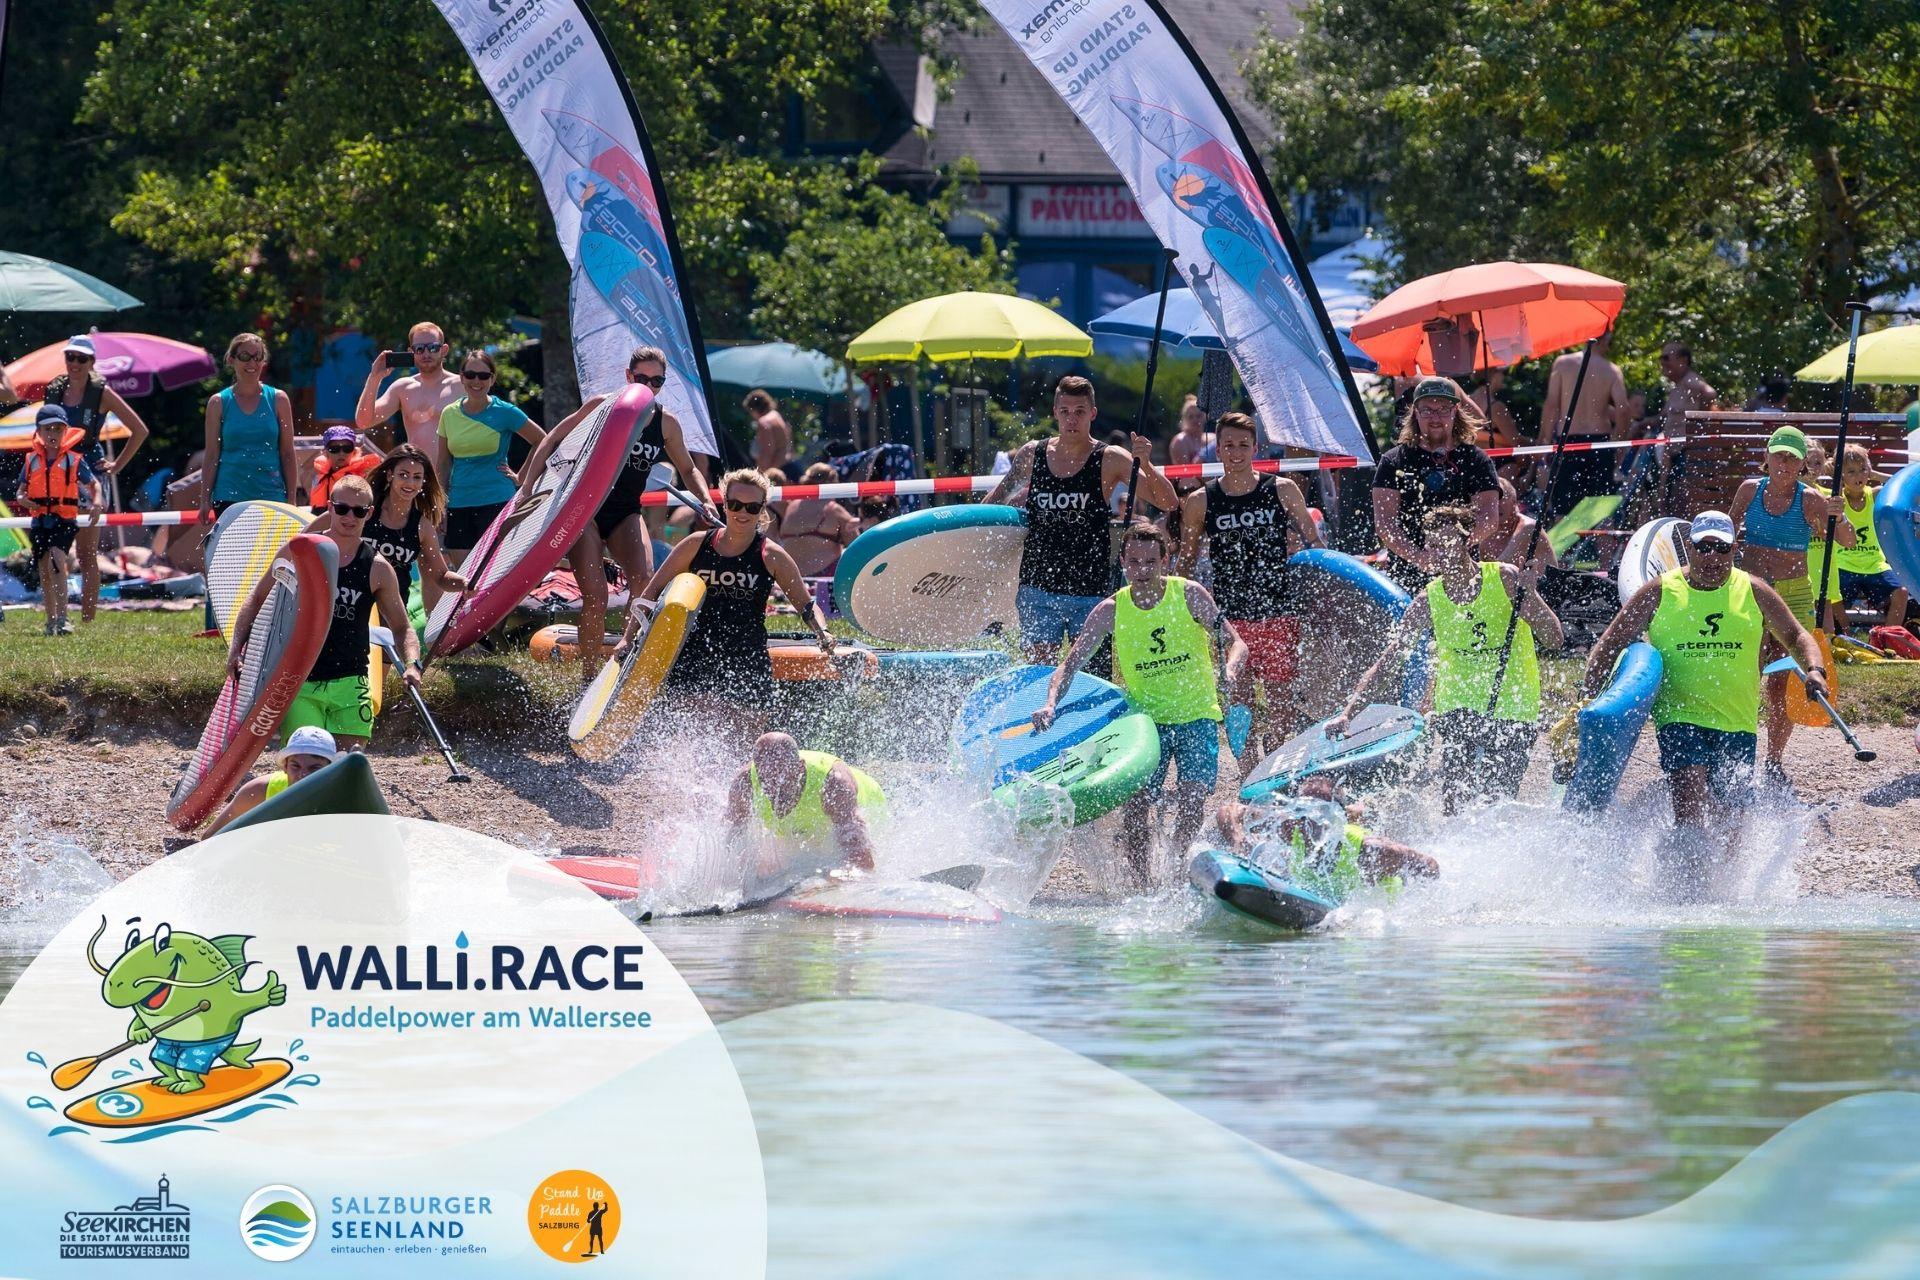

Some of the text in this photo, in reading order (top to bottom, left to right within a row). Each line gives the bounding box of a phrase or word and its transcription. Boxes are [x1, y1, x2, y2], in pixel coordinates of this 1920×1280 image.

[631, 441, 660, 460] ORY
[1037, 493, 1090, 509] GLORY
[1215, 509, 1276, 530] GLORY
[549, 527, 569, 549] GLORY
[707, 586, 754, 600] OARDS
[1676, 641, 1743, 651] stemax
[250, 703, 281, 737] GLORY
